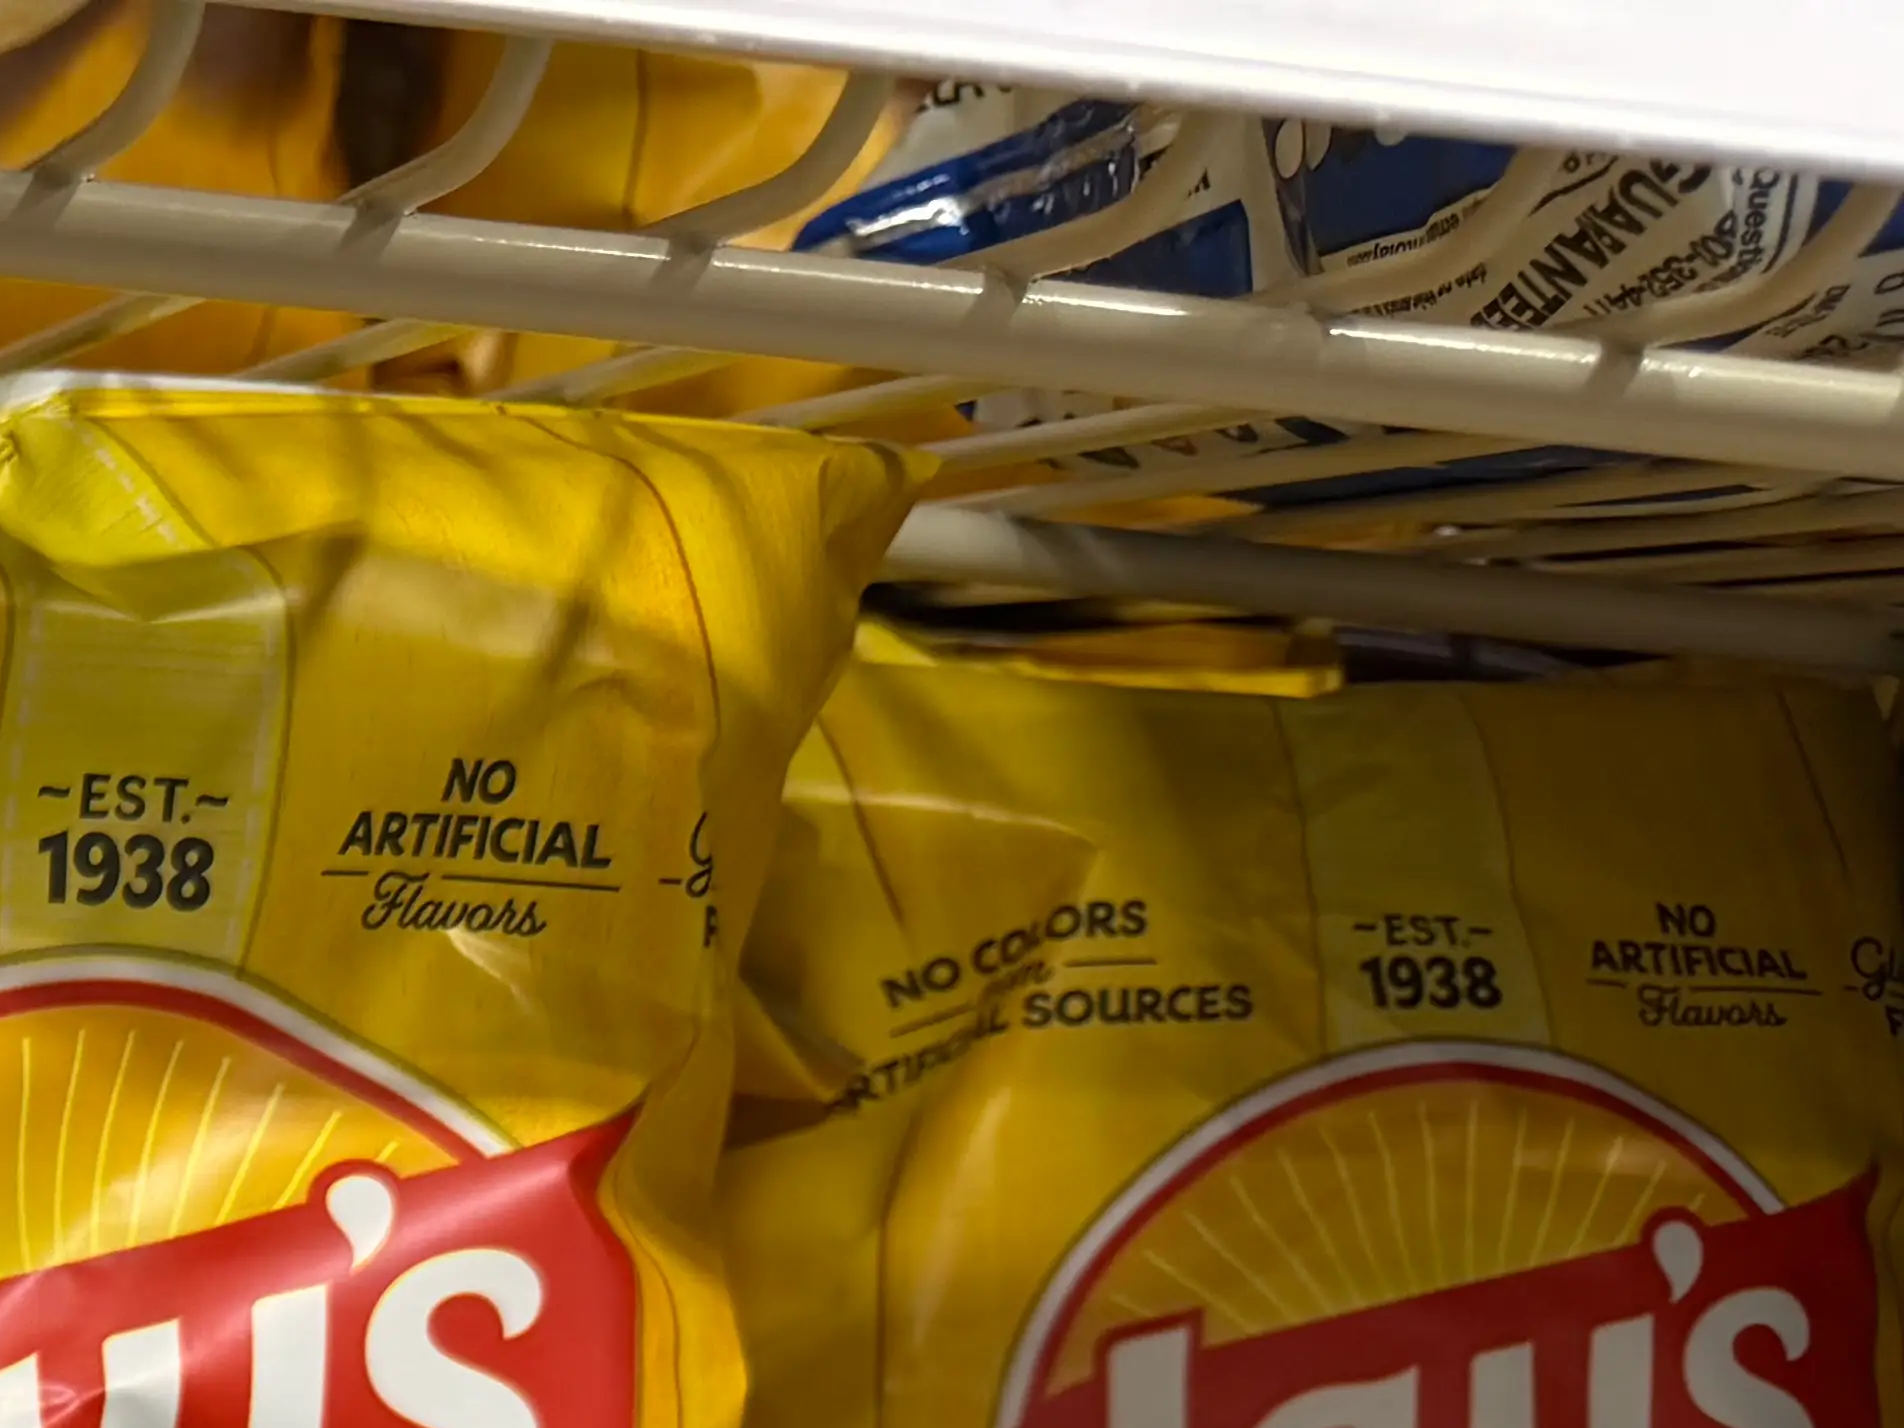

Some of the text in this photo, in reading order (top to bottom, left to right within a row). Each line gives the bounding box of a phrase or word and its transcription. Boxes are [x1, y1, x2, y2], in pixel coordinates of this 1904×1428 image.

[441, 758, 518, 804] NO
[336, 810, 613, 870] ARTIFICIAL
[36, 829, 216, 913] 1938
[361, 871, 548, 938] Flavors
[1655, 902, 1717, 938] NO
[879, 956, 962, 1008] NO
[1358, 955, 1503, 1010] 1938
[1590, 939, 1808, 981] ARTIFICIAL
[1021, 984, 1255, 1030] SOURCES
[1637, 983, 1788, 1027] Flavors
